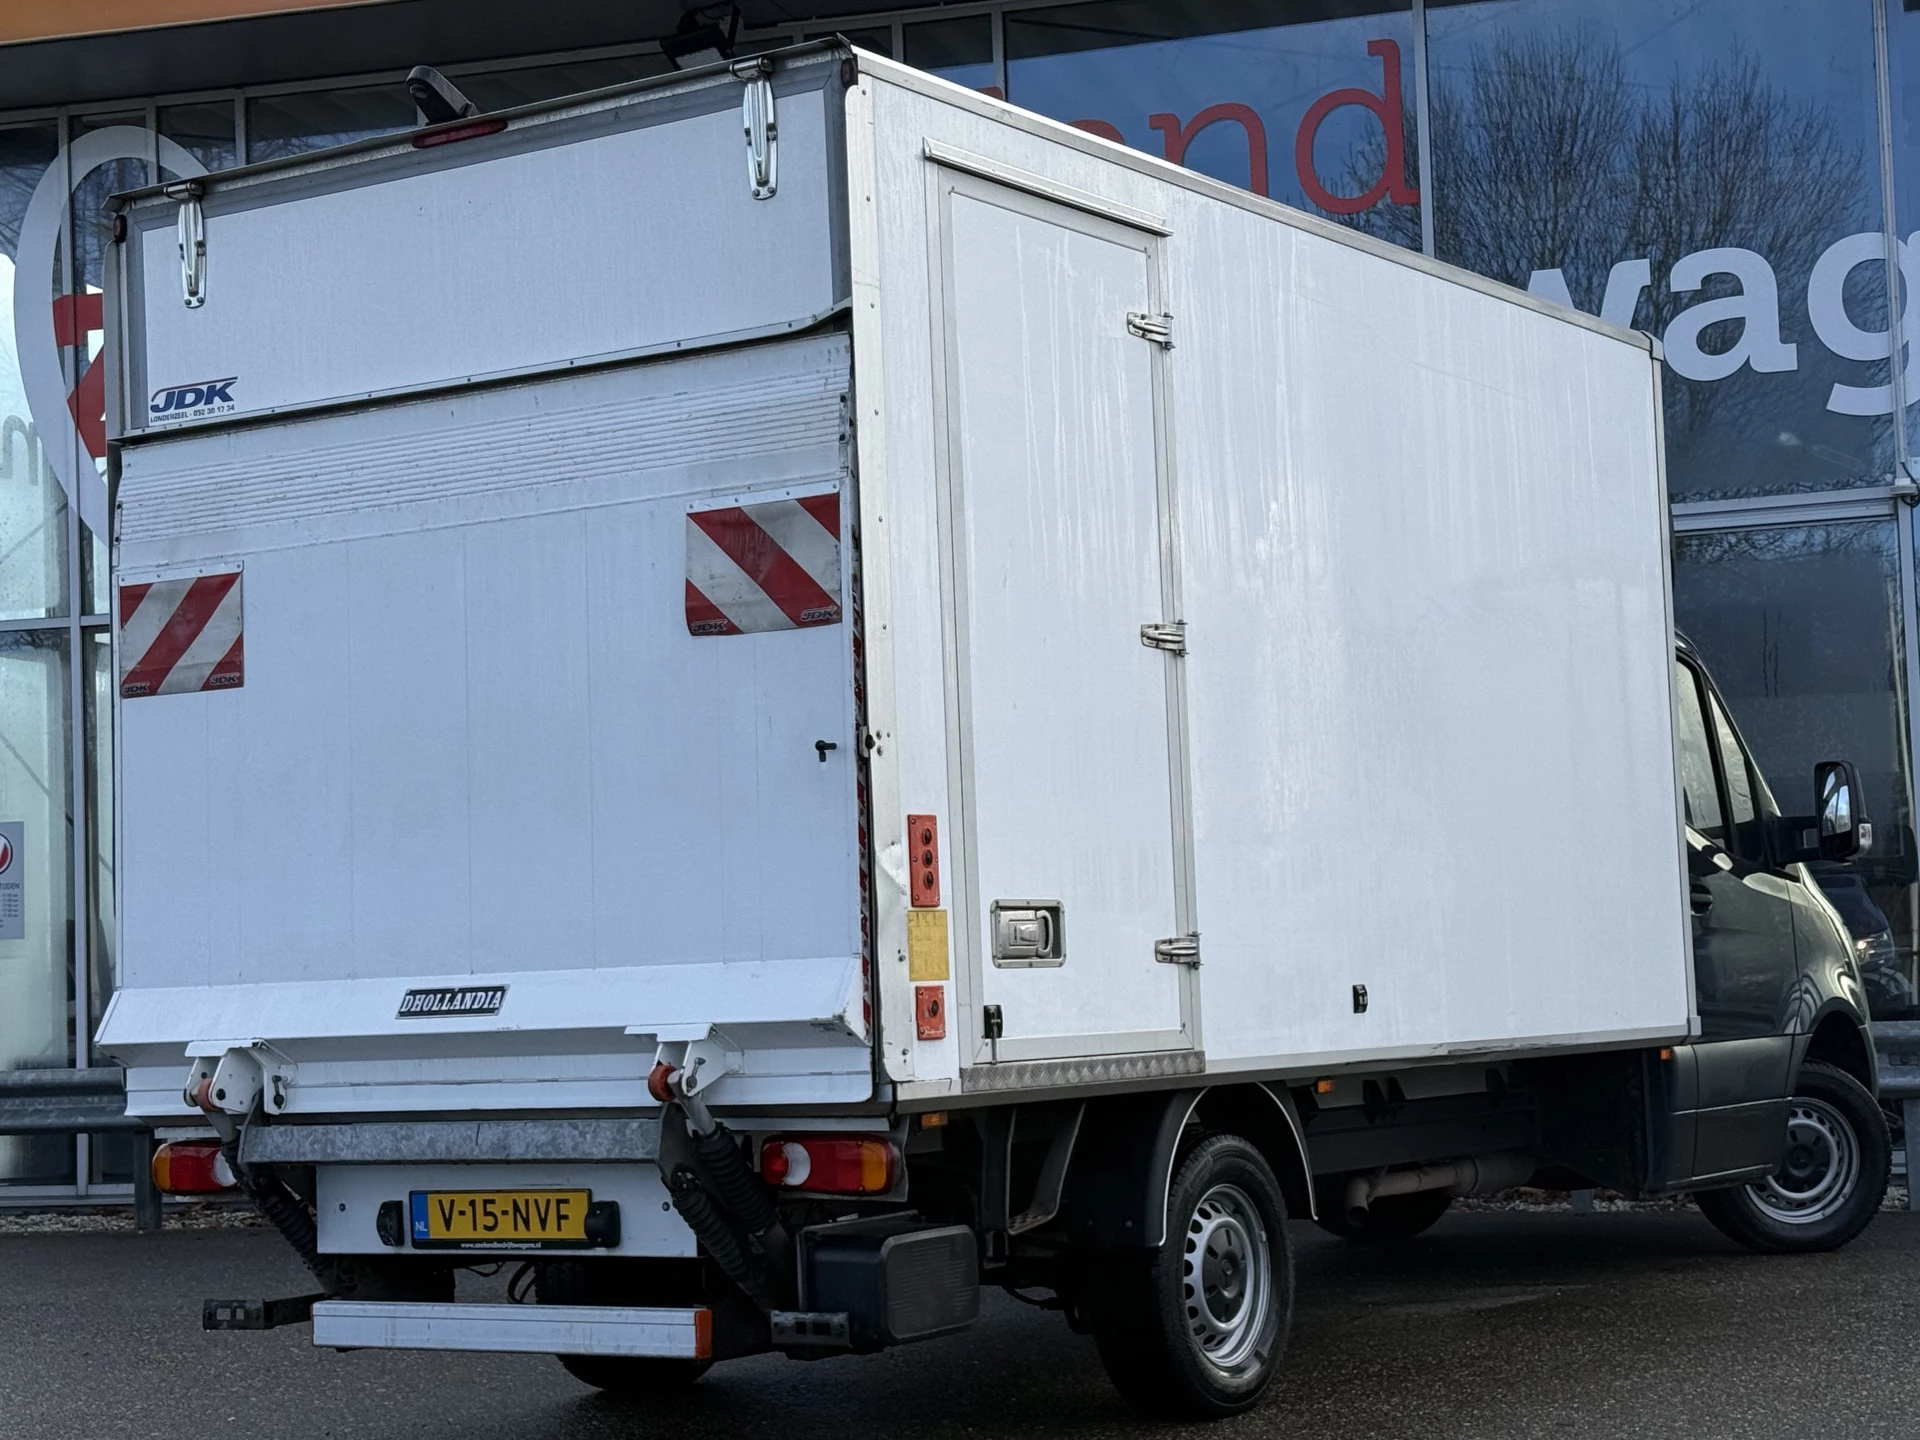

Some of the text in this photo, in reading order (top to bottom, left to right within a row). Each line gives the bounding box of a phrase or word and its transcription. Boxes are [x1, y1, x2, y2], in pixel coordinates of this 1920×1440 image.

[150, 381, 237, 413] JDK
[150, 411, 189, 423] LONDERZEEL
[802, 610, 834, 621] JDK
[693, 622, 724, 632] JDK
[211, 675, 237, 685] JDK
[123, 684, 149, 693] JDK
[400, 991, 503, 1012] DHOLLANDIA
[438, 1198, 570, 1232] V-15-NVF
[415, 1220, 428, 1232] NL
